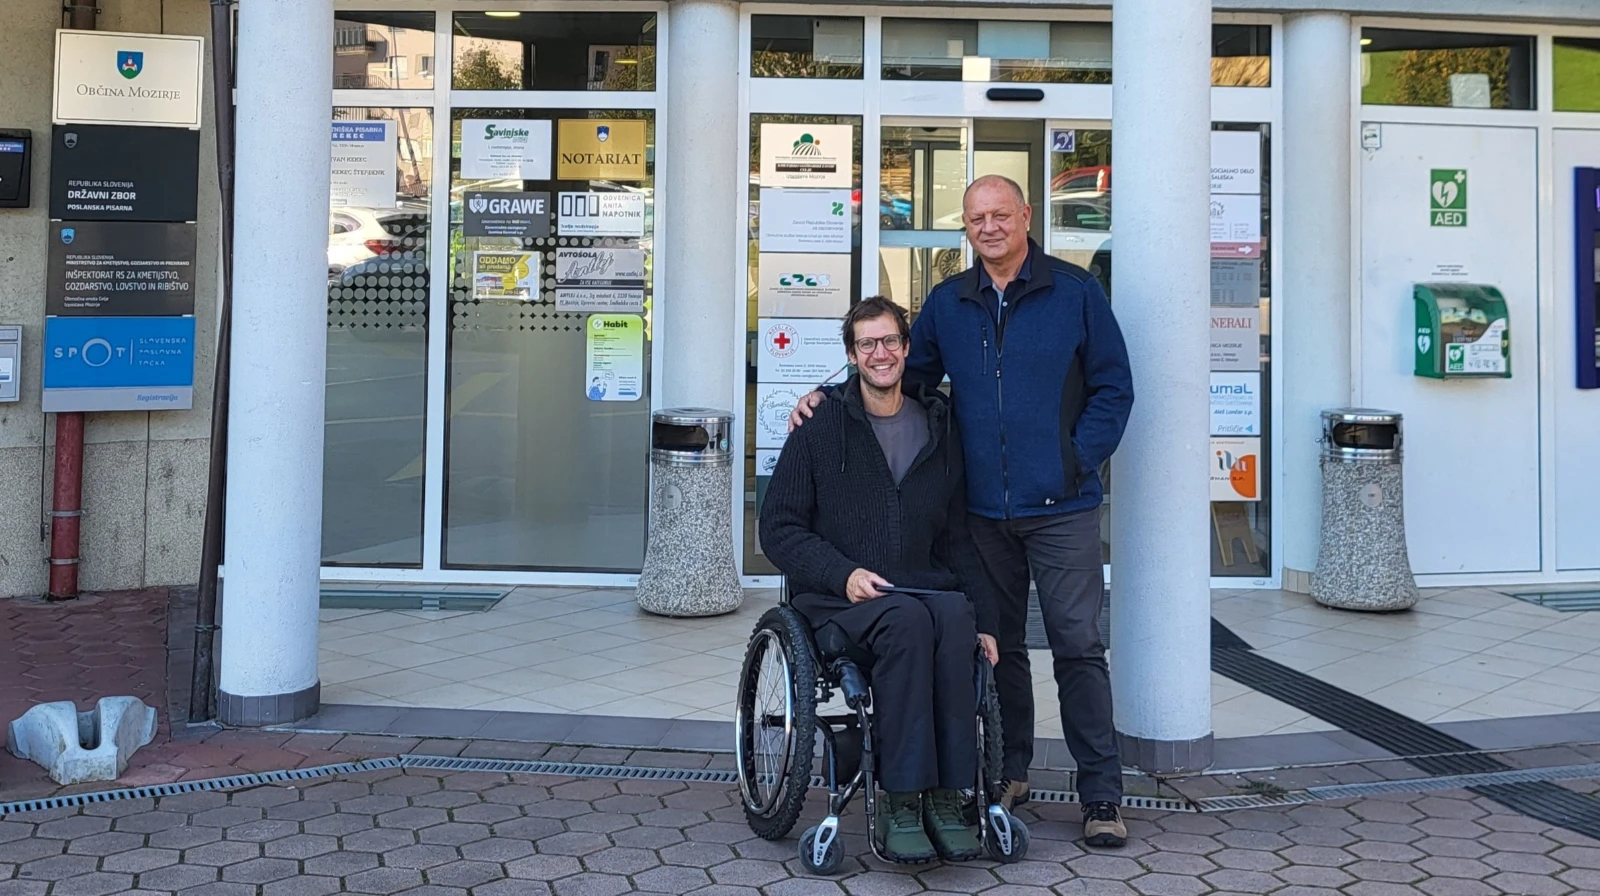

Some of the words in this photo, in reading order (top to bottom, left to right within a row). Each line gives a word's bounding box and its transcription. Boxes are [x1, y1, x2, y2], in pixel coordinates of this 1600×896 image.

[76, 84, 124, 98] OBČINA
[128, 86, 181, 100] MOZIRJE
[484, 124, 529, 140] Savinjske
[562, 153, 642, 165] NOTARIAT
[103, 181, 134, 189] SLOVENIJA
[67, 189, 109, 200] DRŽAVNI
[110, 191, 136, 200] ZBOR
[488, 198, 545, 214] GRAWE
[1434, 212, 1462, 225] AED
[66, 270, 114, 279] INŠPEKTORAT
[116, 271, 125, 279] RS
[126, 271, 136, 280] ZA
[136, 271, 180, 280] KMETIJSTVO,
[65, 282, 114, 291] GOZDARSTVO,
[116, 282, 146, 290] LOVSTVO
[158, 281, 188, 290] RIBIŠTVO
[1210, 318, 1252, 328] NERALI
[54, 338, 127, 367] SPOT
[137, 394, 178, 402] Registracija
